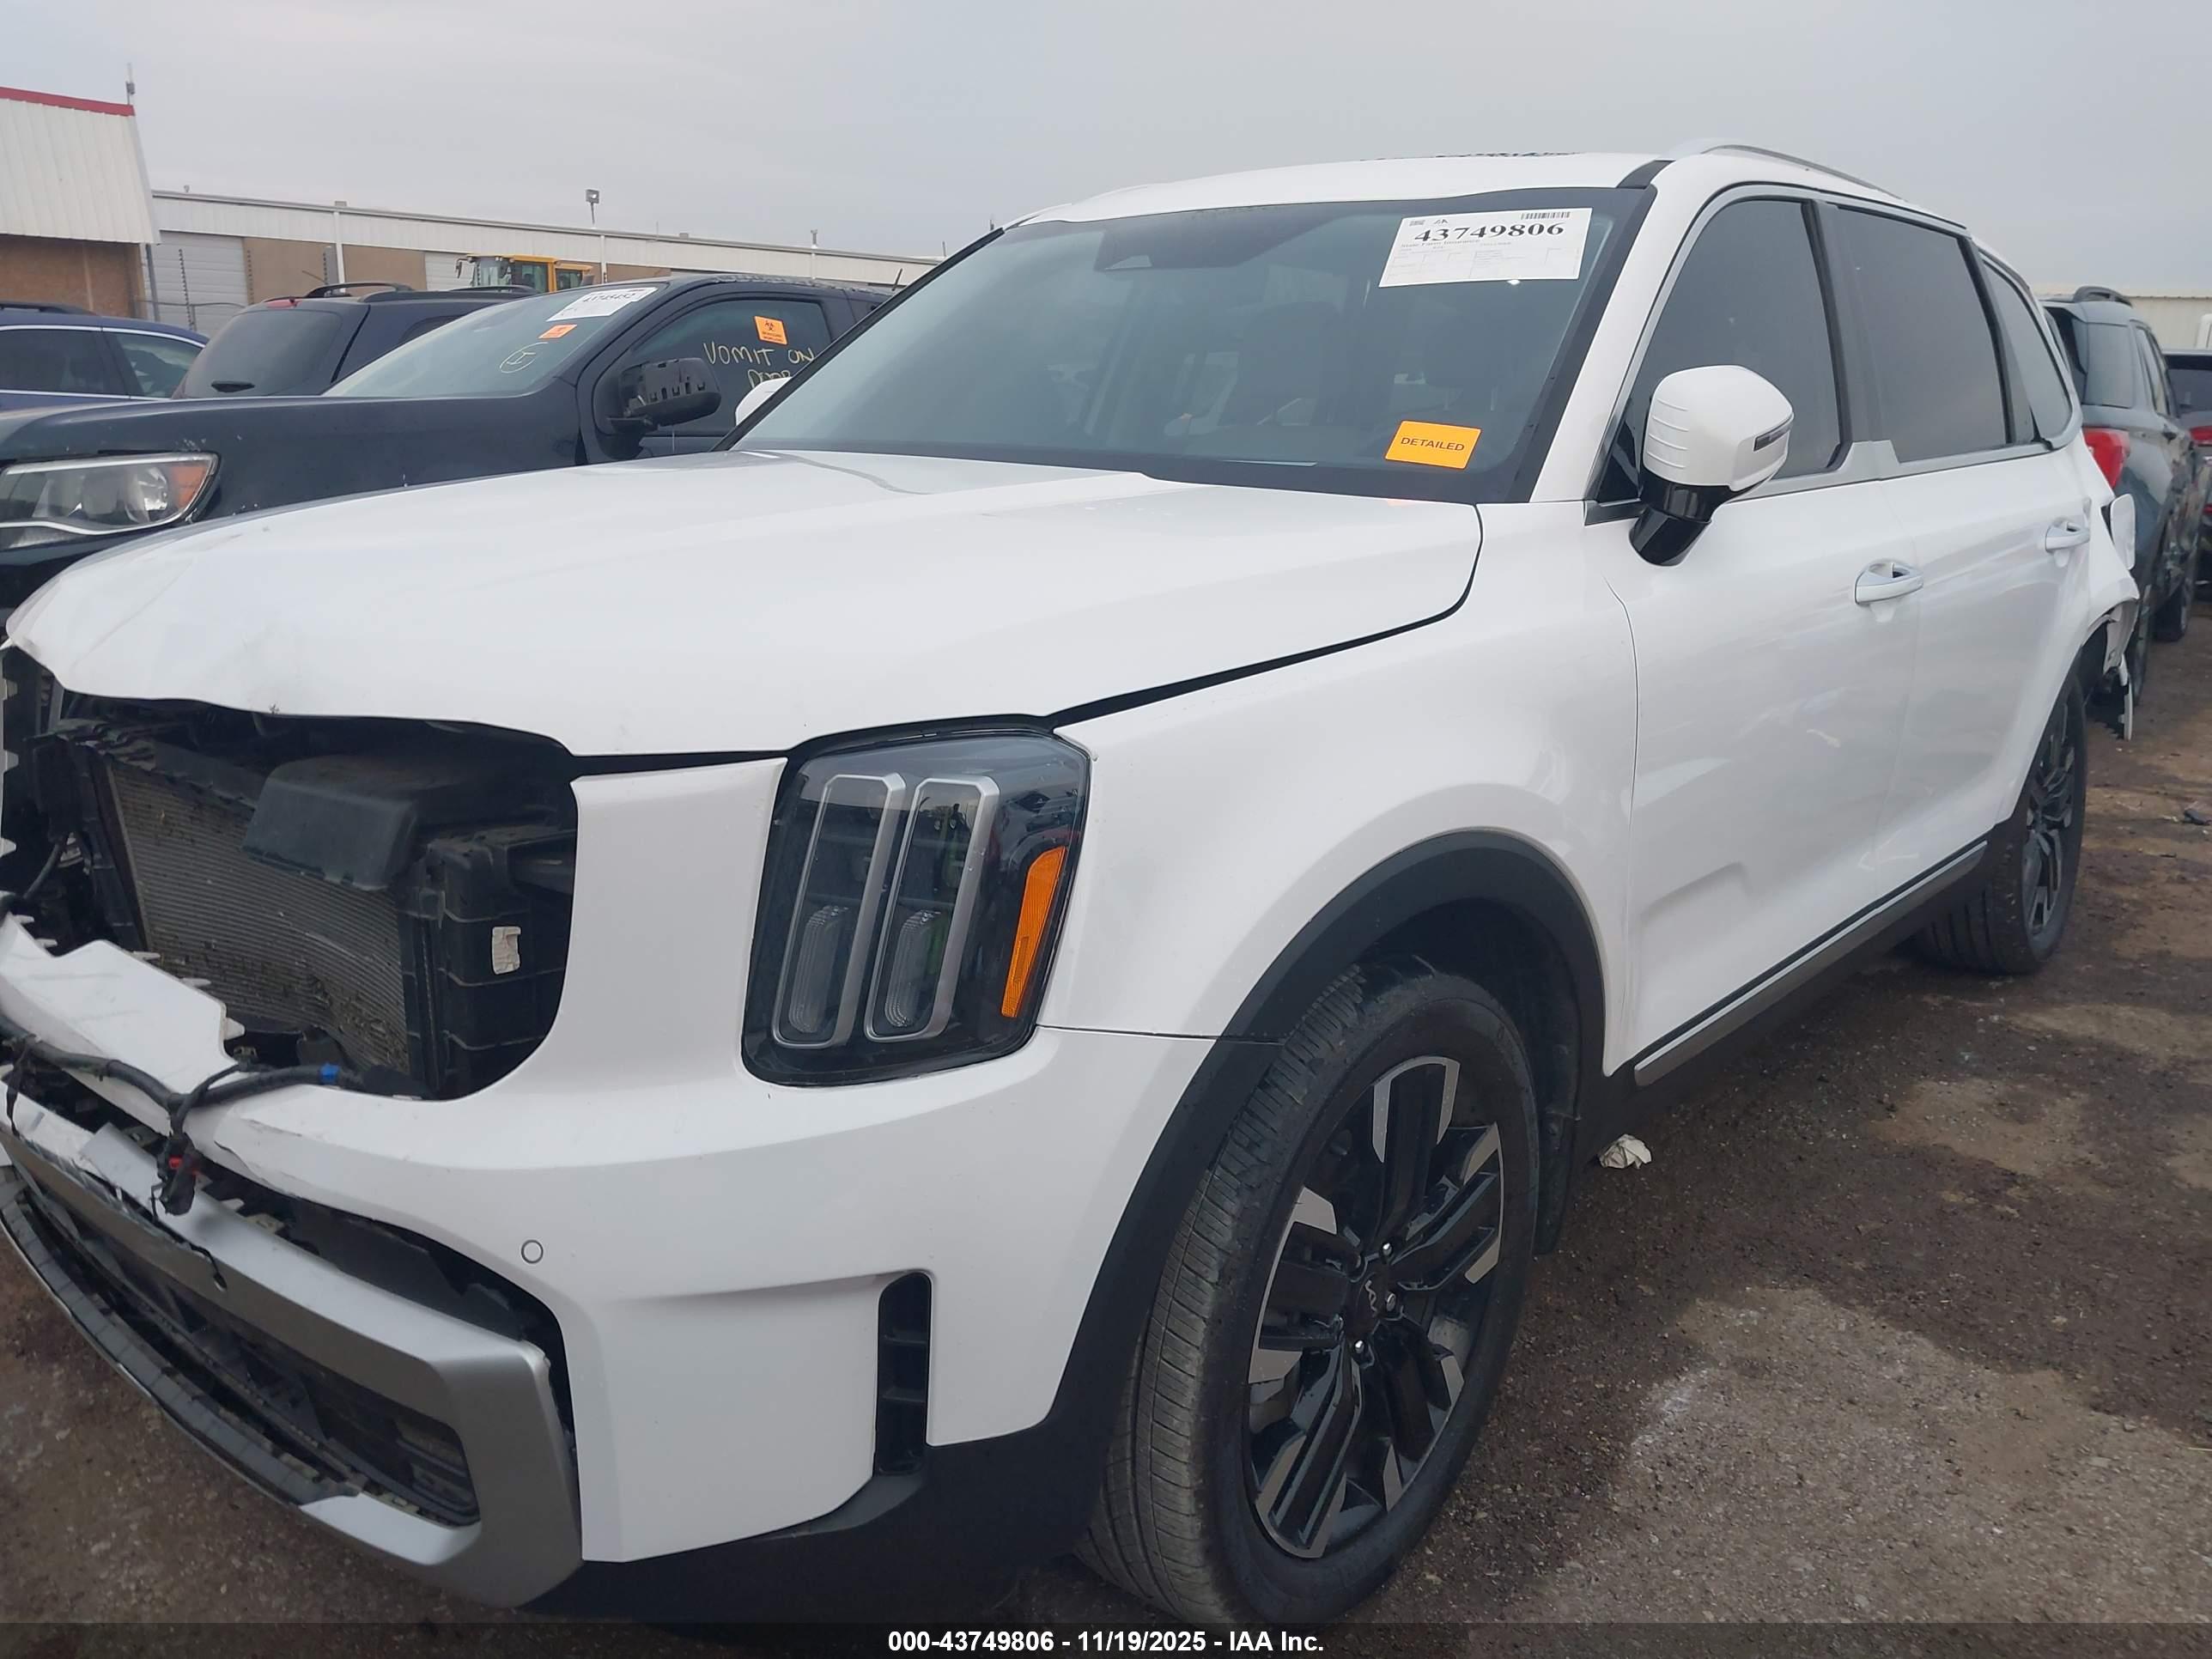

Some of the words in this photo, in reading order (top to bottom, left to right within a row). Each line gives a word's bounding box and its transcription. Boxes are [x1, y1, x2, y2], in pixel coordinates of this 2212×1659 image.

[1414, 222, 1565, 241] 43749806
[703, 341, 775, 367] VOMIT
[787, 347, 815, 364] ON
[1401, 437, 1465, 451] DETAILED
